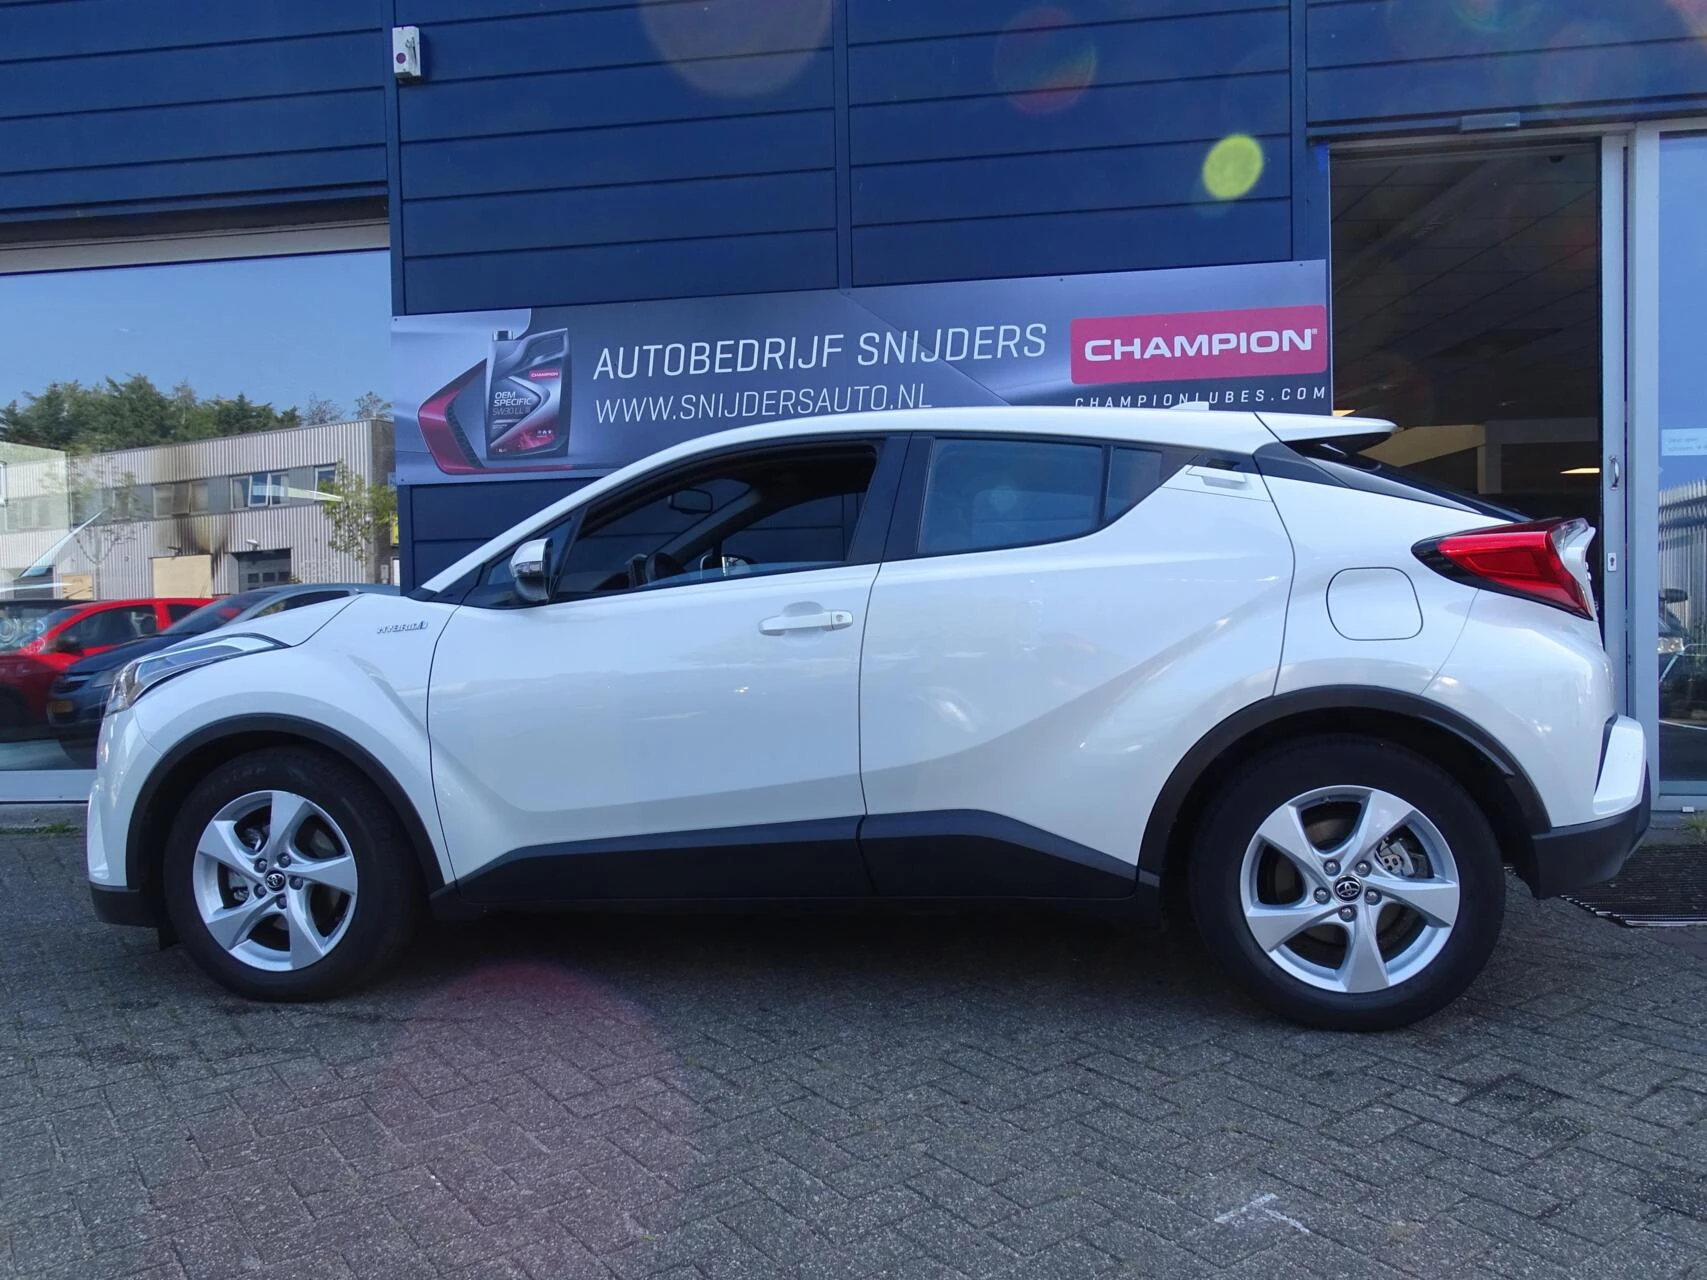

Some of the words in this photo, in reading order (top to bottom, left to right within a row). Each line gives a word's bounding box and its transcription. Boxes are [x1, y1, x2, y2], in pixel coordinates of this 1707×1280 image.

[593, 334, 844, 380] AUTOBEDRIJF
[857, 323, 1047, 366] SNIJDERS
[1084, 328, 1313, 362] CHAMPION
[493, 398, 533, 407] SPECIFIC
[494, 391, 516, 400] OEM
[595, 383, 933, 424] WWW.SNIJDERSAUTO.NL
